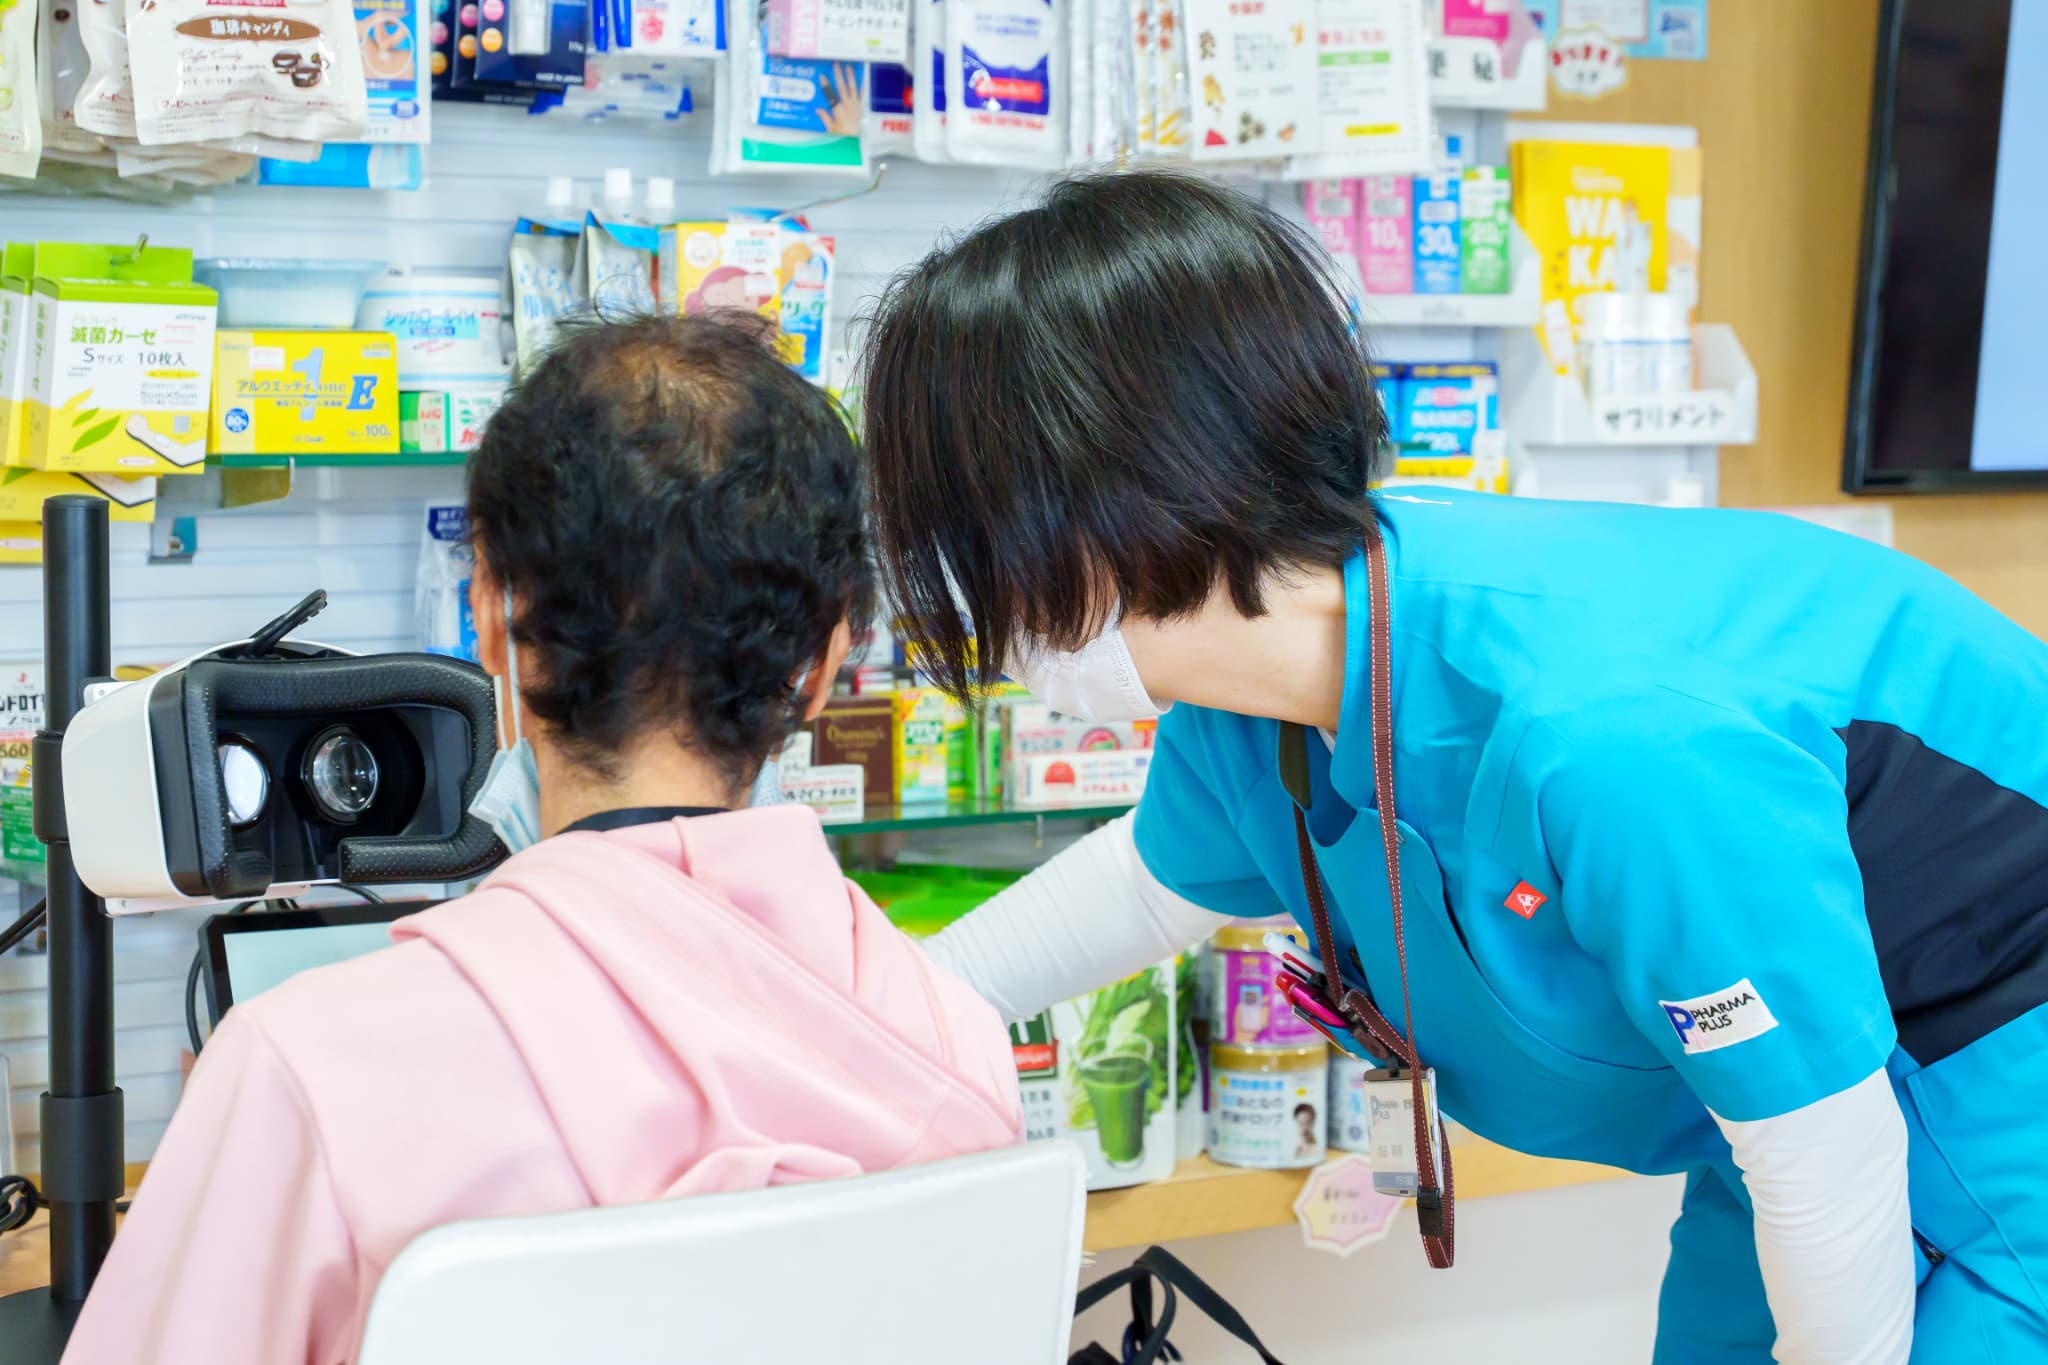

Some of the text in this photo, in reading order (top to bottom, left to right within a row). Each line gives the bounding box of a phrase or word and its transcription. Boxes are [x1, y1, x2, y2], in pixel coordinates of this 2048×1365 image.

[138, 351, 187, 367] 10枚入
[1690, 992, 1756, 1020] PHARMA
[1698, 1014, 1733, 1033] PLUS
